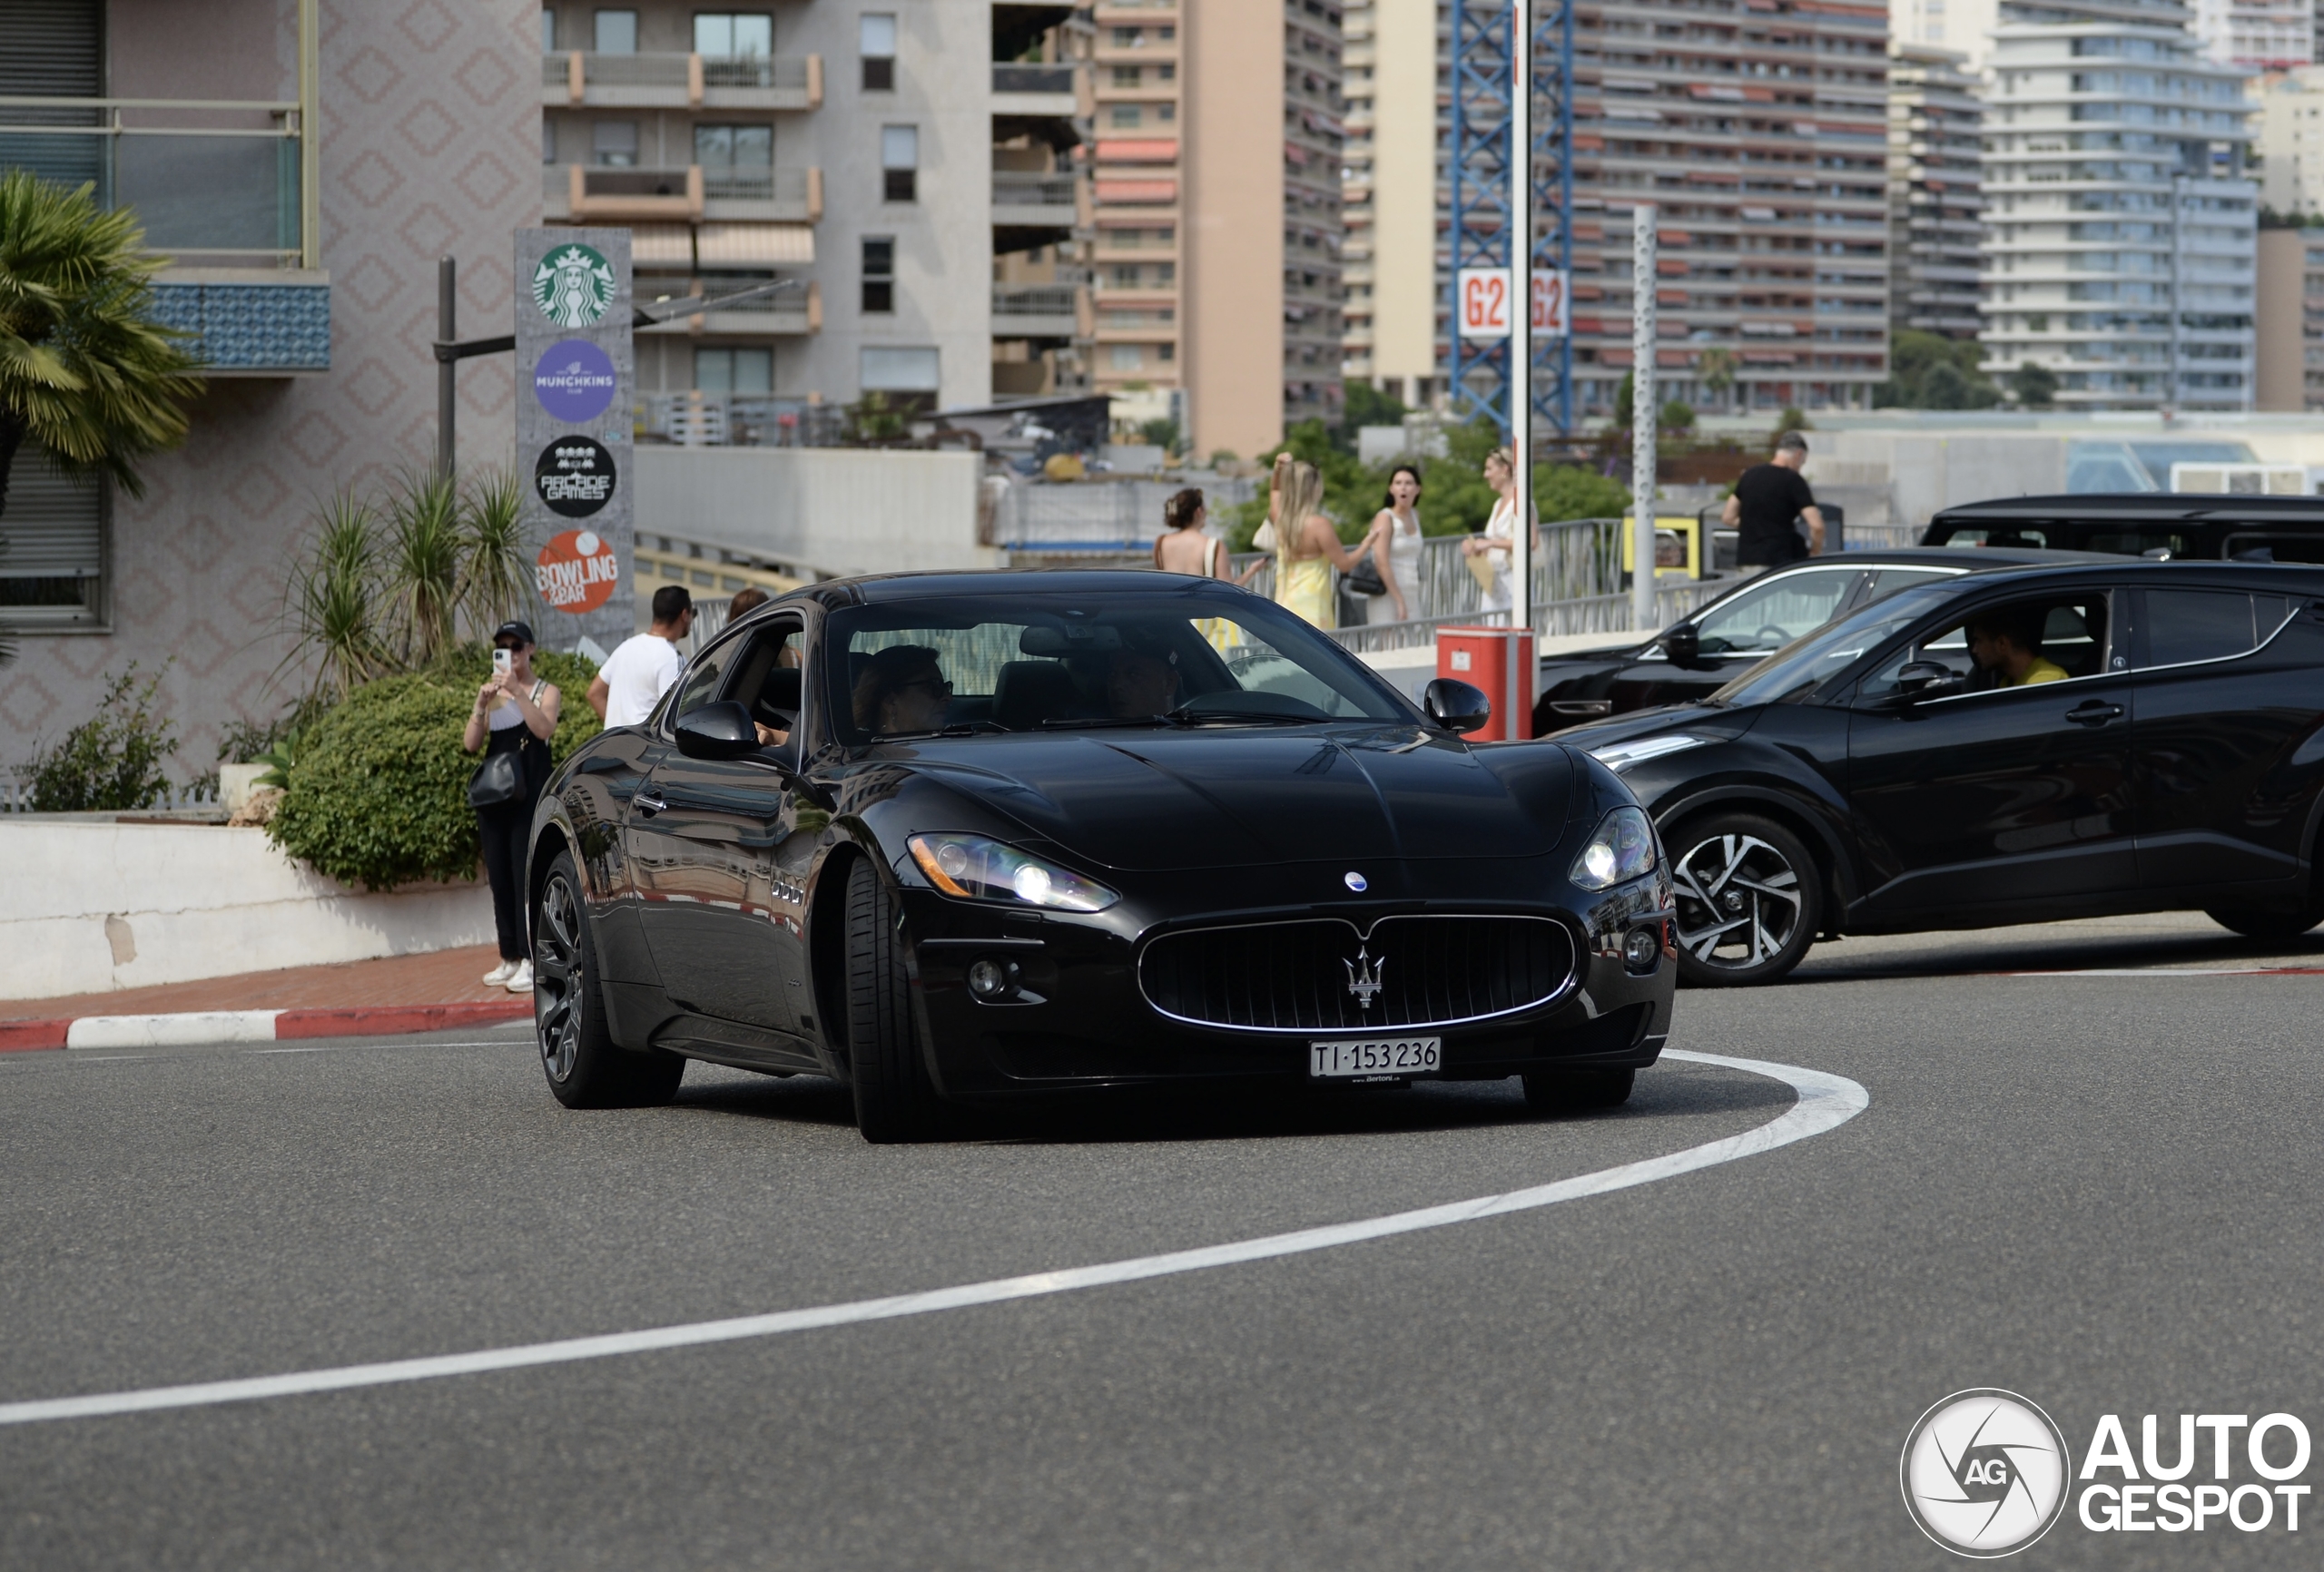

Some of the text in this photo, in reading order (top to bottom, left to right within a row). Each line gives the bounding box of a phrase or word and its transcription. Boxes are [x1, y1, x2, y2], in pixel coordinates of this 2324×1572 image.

[1466, 278, 1503, 326] G2
[537, 376, 614, 388] MUNCHKINS
[541, 476, 610, 488] ARCADE
[547, 488, 605, 500] GAMES
[536, 555, 618, 591] BOWLING
[548, 584, 586, 606] &BAR
